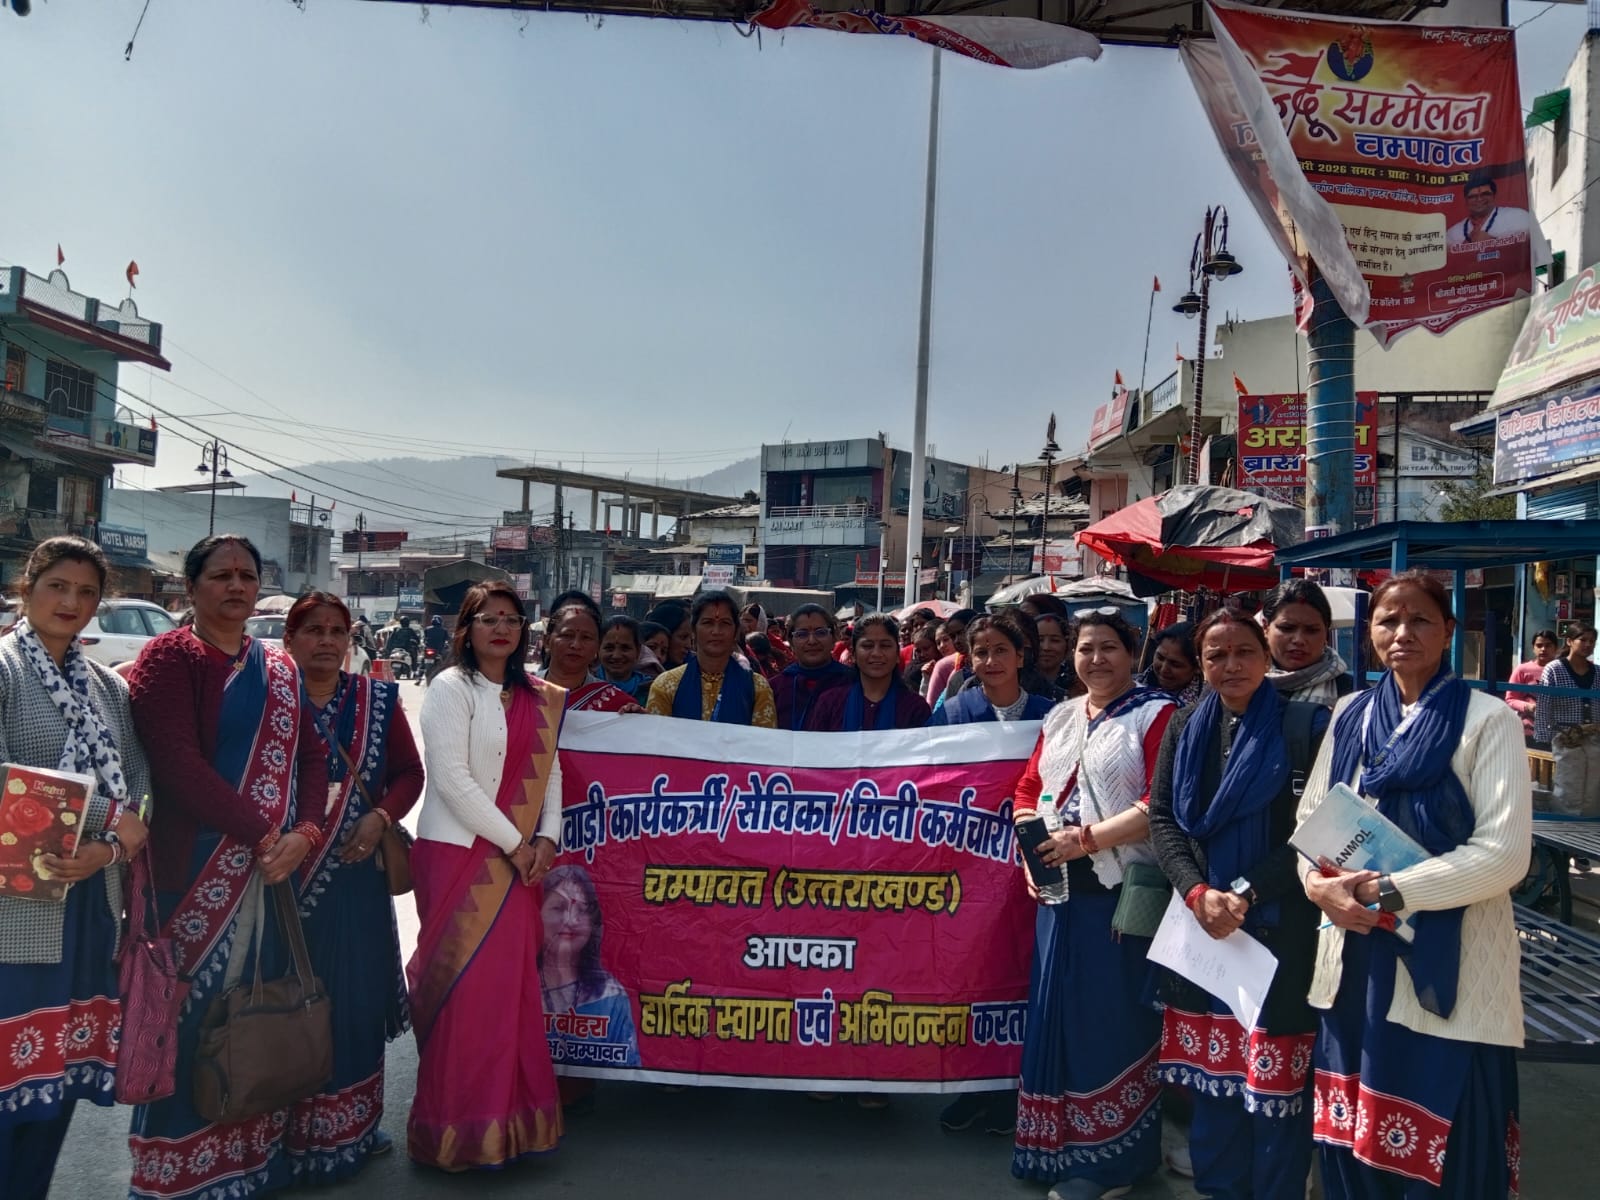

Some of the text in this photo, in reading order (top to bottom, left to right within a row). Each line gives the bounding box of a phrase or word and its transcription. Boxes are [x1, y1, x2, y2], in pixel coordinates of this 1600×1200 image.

[1331, 84, 1487, 132] सम्मेलन
[1354, 133, 1484, 167] चम्पावत
[1318, 163, 1347, 173] 2026
[1351, 166, 1377, 177] समय
[1415, 173, 1445, 185] 11.00
[1402, 232, 1412, 241] की
[101, 531, 124, 547] HOTEL
[920, 787, 1016, 863] कर्मचारी
[1335, 828, 1372, 867] ANMOL
[643, 864, 769, 906] चम्पावत
[743, 935, 858, 971] आपका
[555, 1007, 611, 1039] बोहरा
[640, 977, 713, 1038] हार्दिक
[714, 998, 795, 1043] स्वागत
[795, 988, 836, 1047] एवं
[838, 988, 971, 1047] अभिनन्दन
[565, 1040, 630, 1063] चम्पावत
